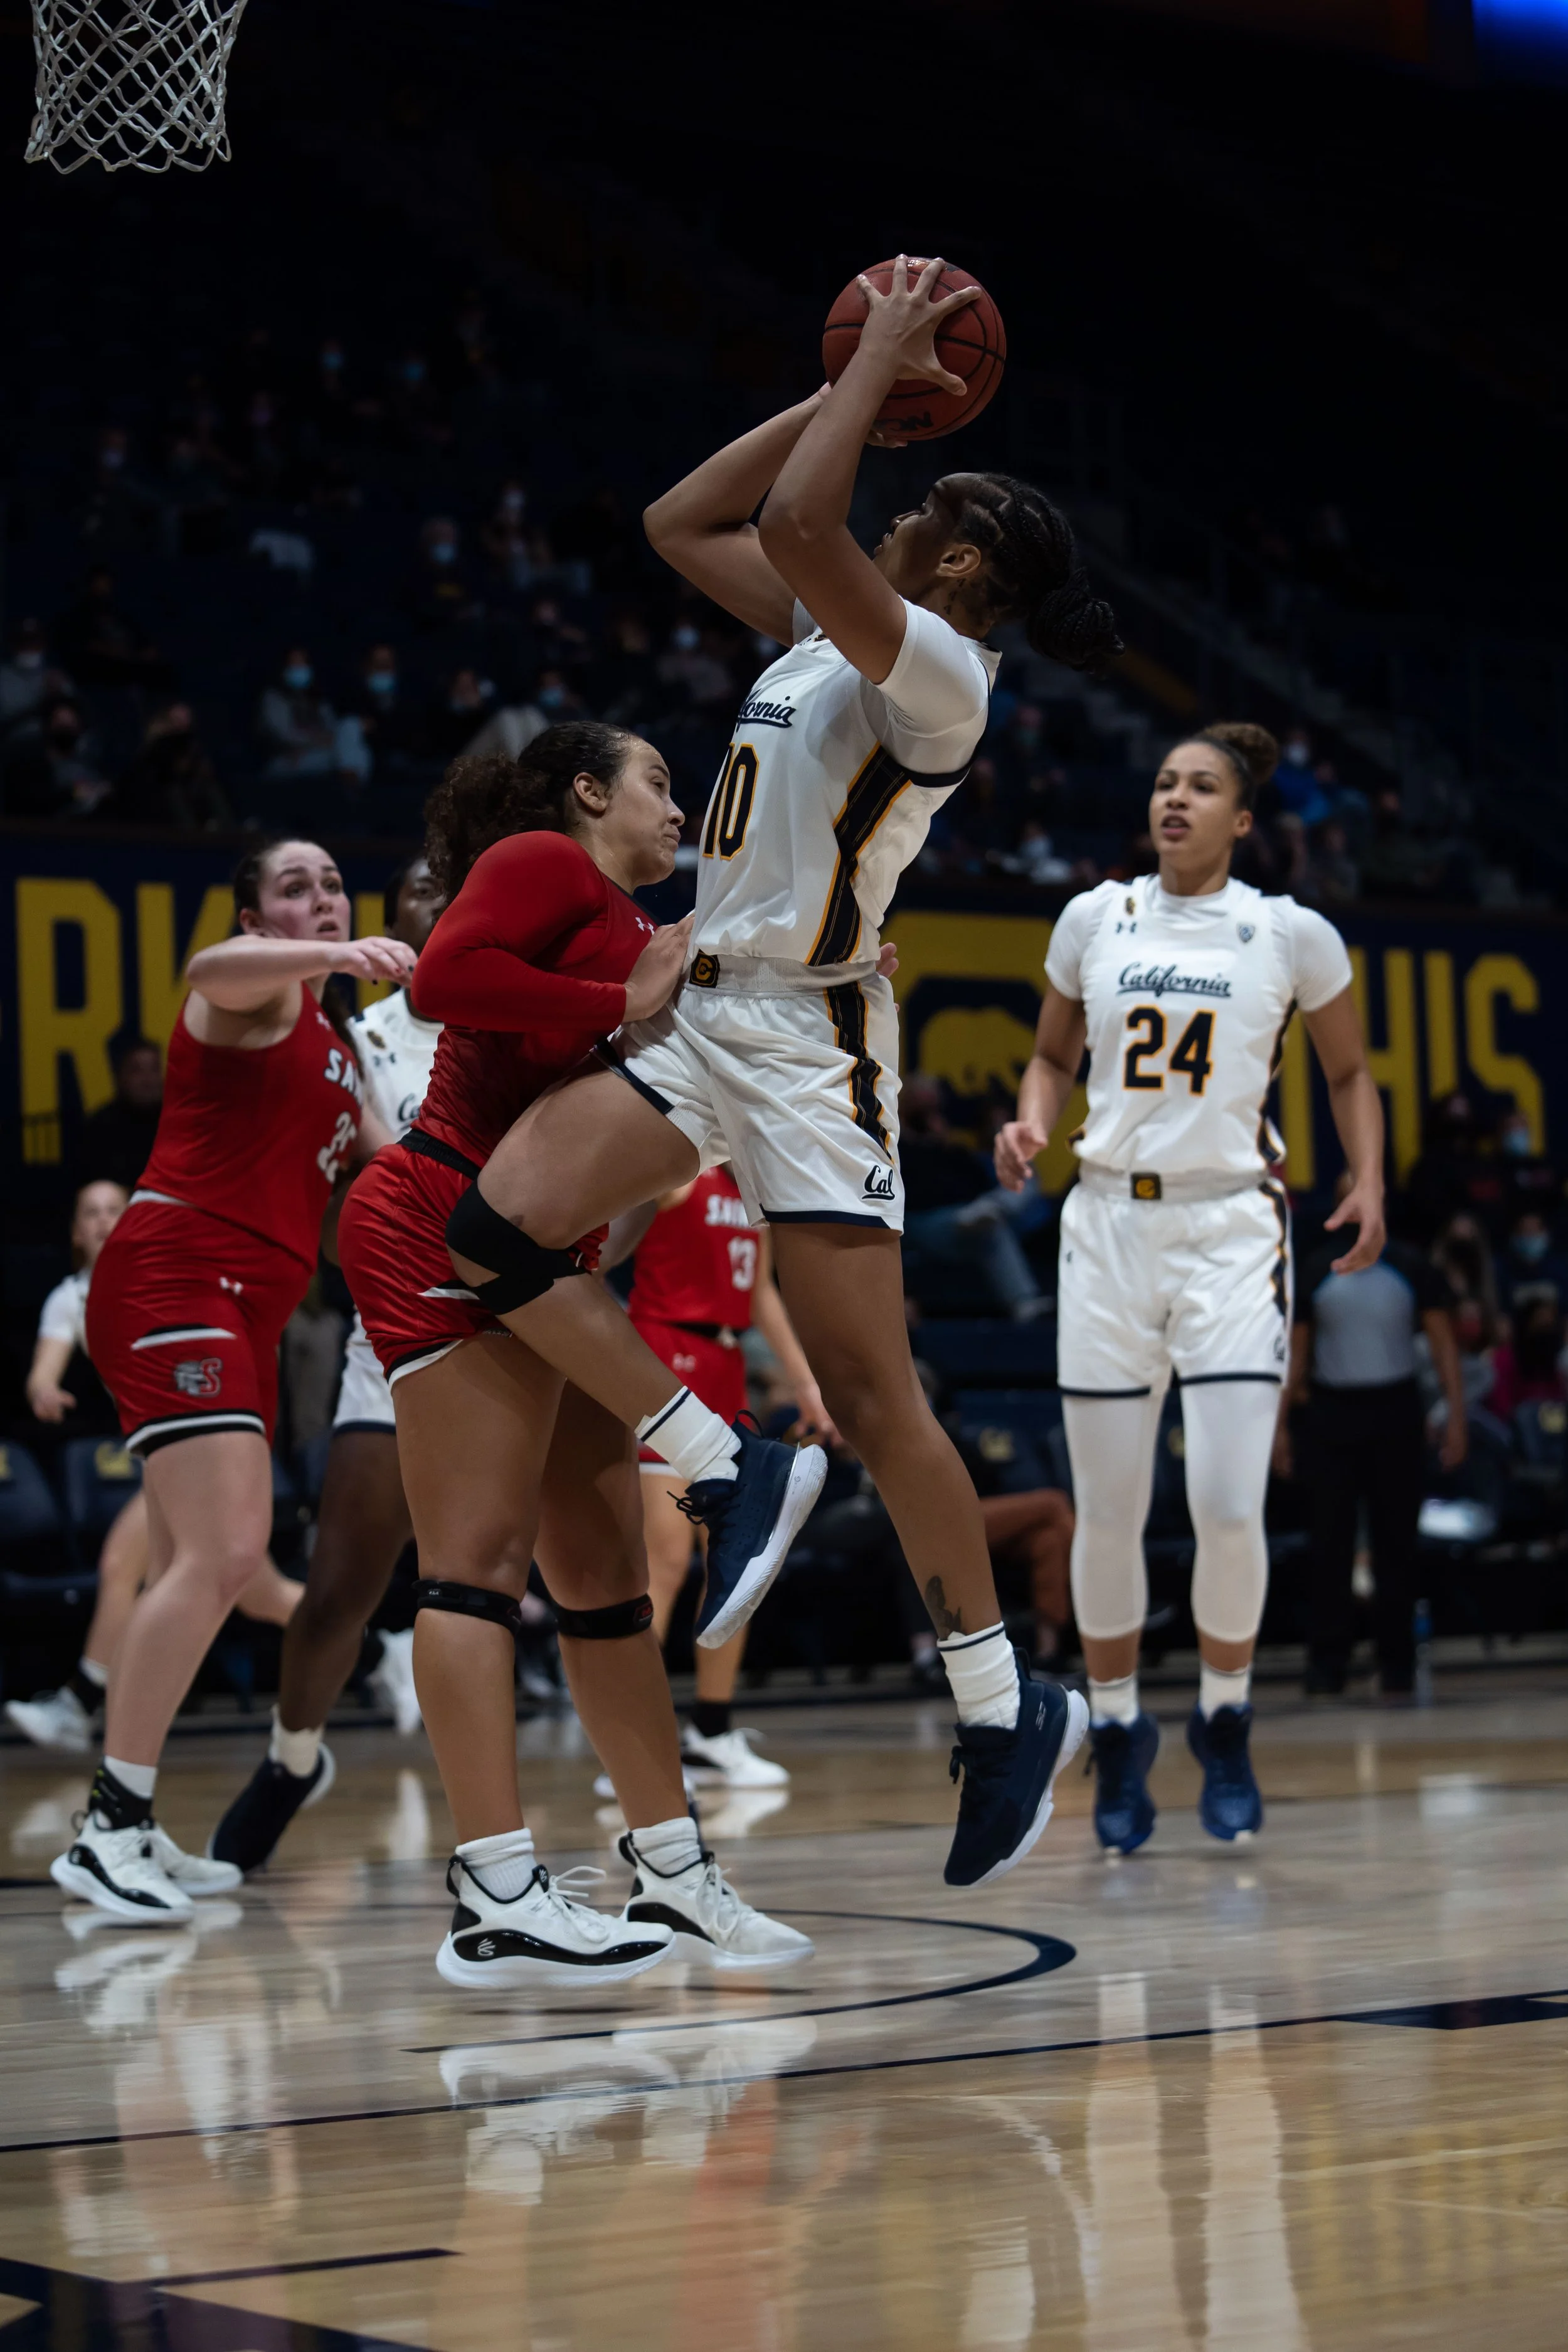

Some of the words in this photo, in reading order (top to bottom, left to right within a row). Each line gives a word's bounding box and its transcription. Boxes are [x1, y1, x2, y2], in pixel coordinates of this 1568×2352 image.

[702, 742, 760, 861] 10
[1116, 961, 1231, 999] California
[1123, 1004, 1216, 1097] 24
[861, 1165, 896, 1200] Cal
[727, 1236, 757, 1291] 13
